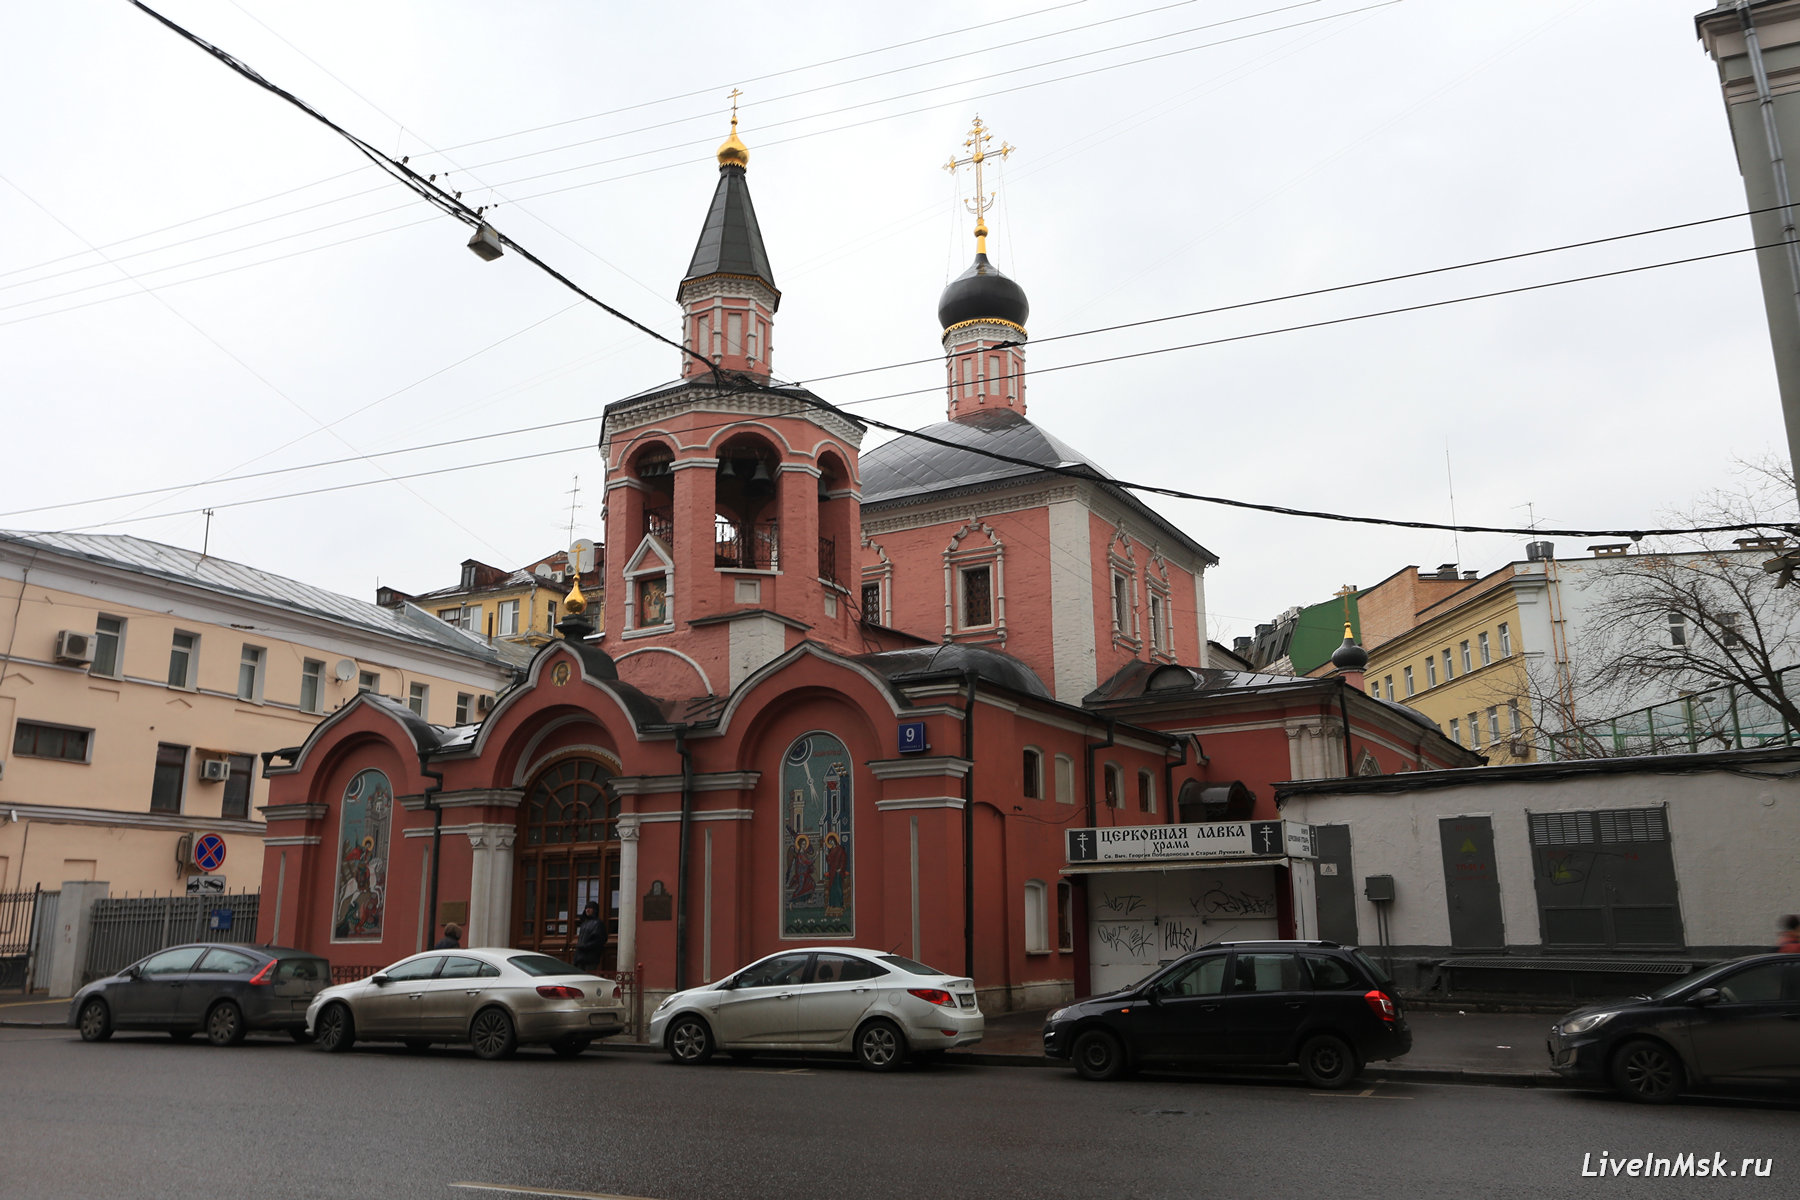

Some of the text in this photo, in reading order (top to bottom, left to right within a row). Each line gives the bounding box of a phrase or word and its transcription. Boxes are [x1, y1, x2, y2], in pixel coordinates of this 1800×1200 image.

[906, 728, 915, 742] 9
[1101, 825, 1246, 844] ЦЕРКОВНАЯ ЛАВКА
[1153, 840, 1190, 853] храма
